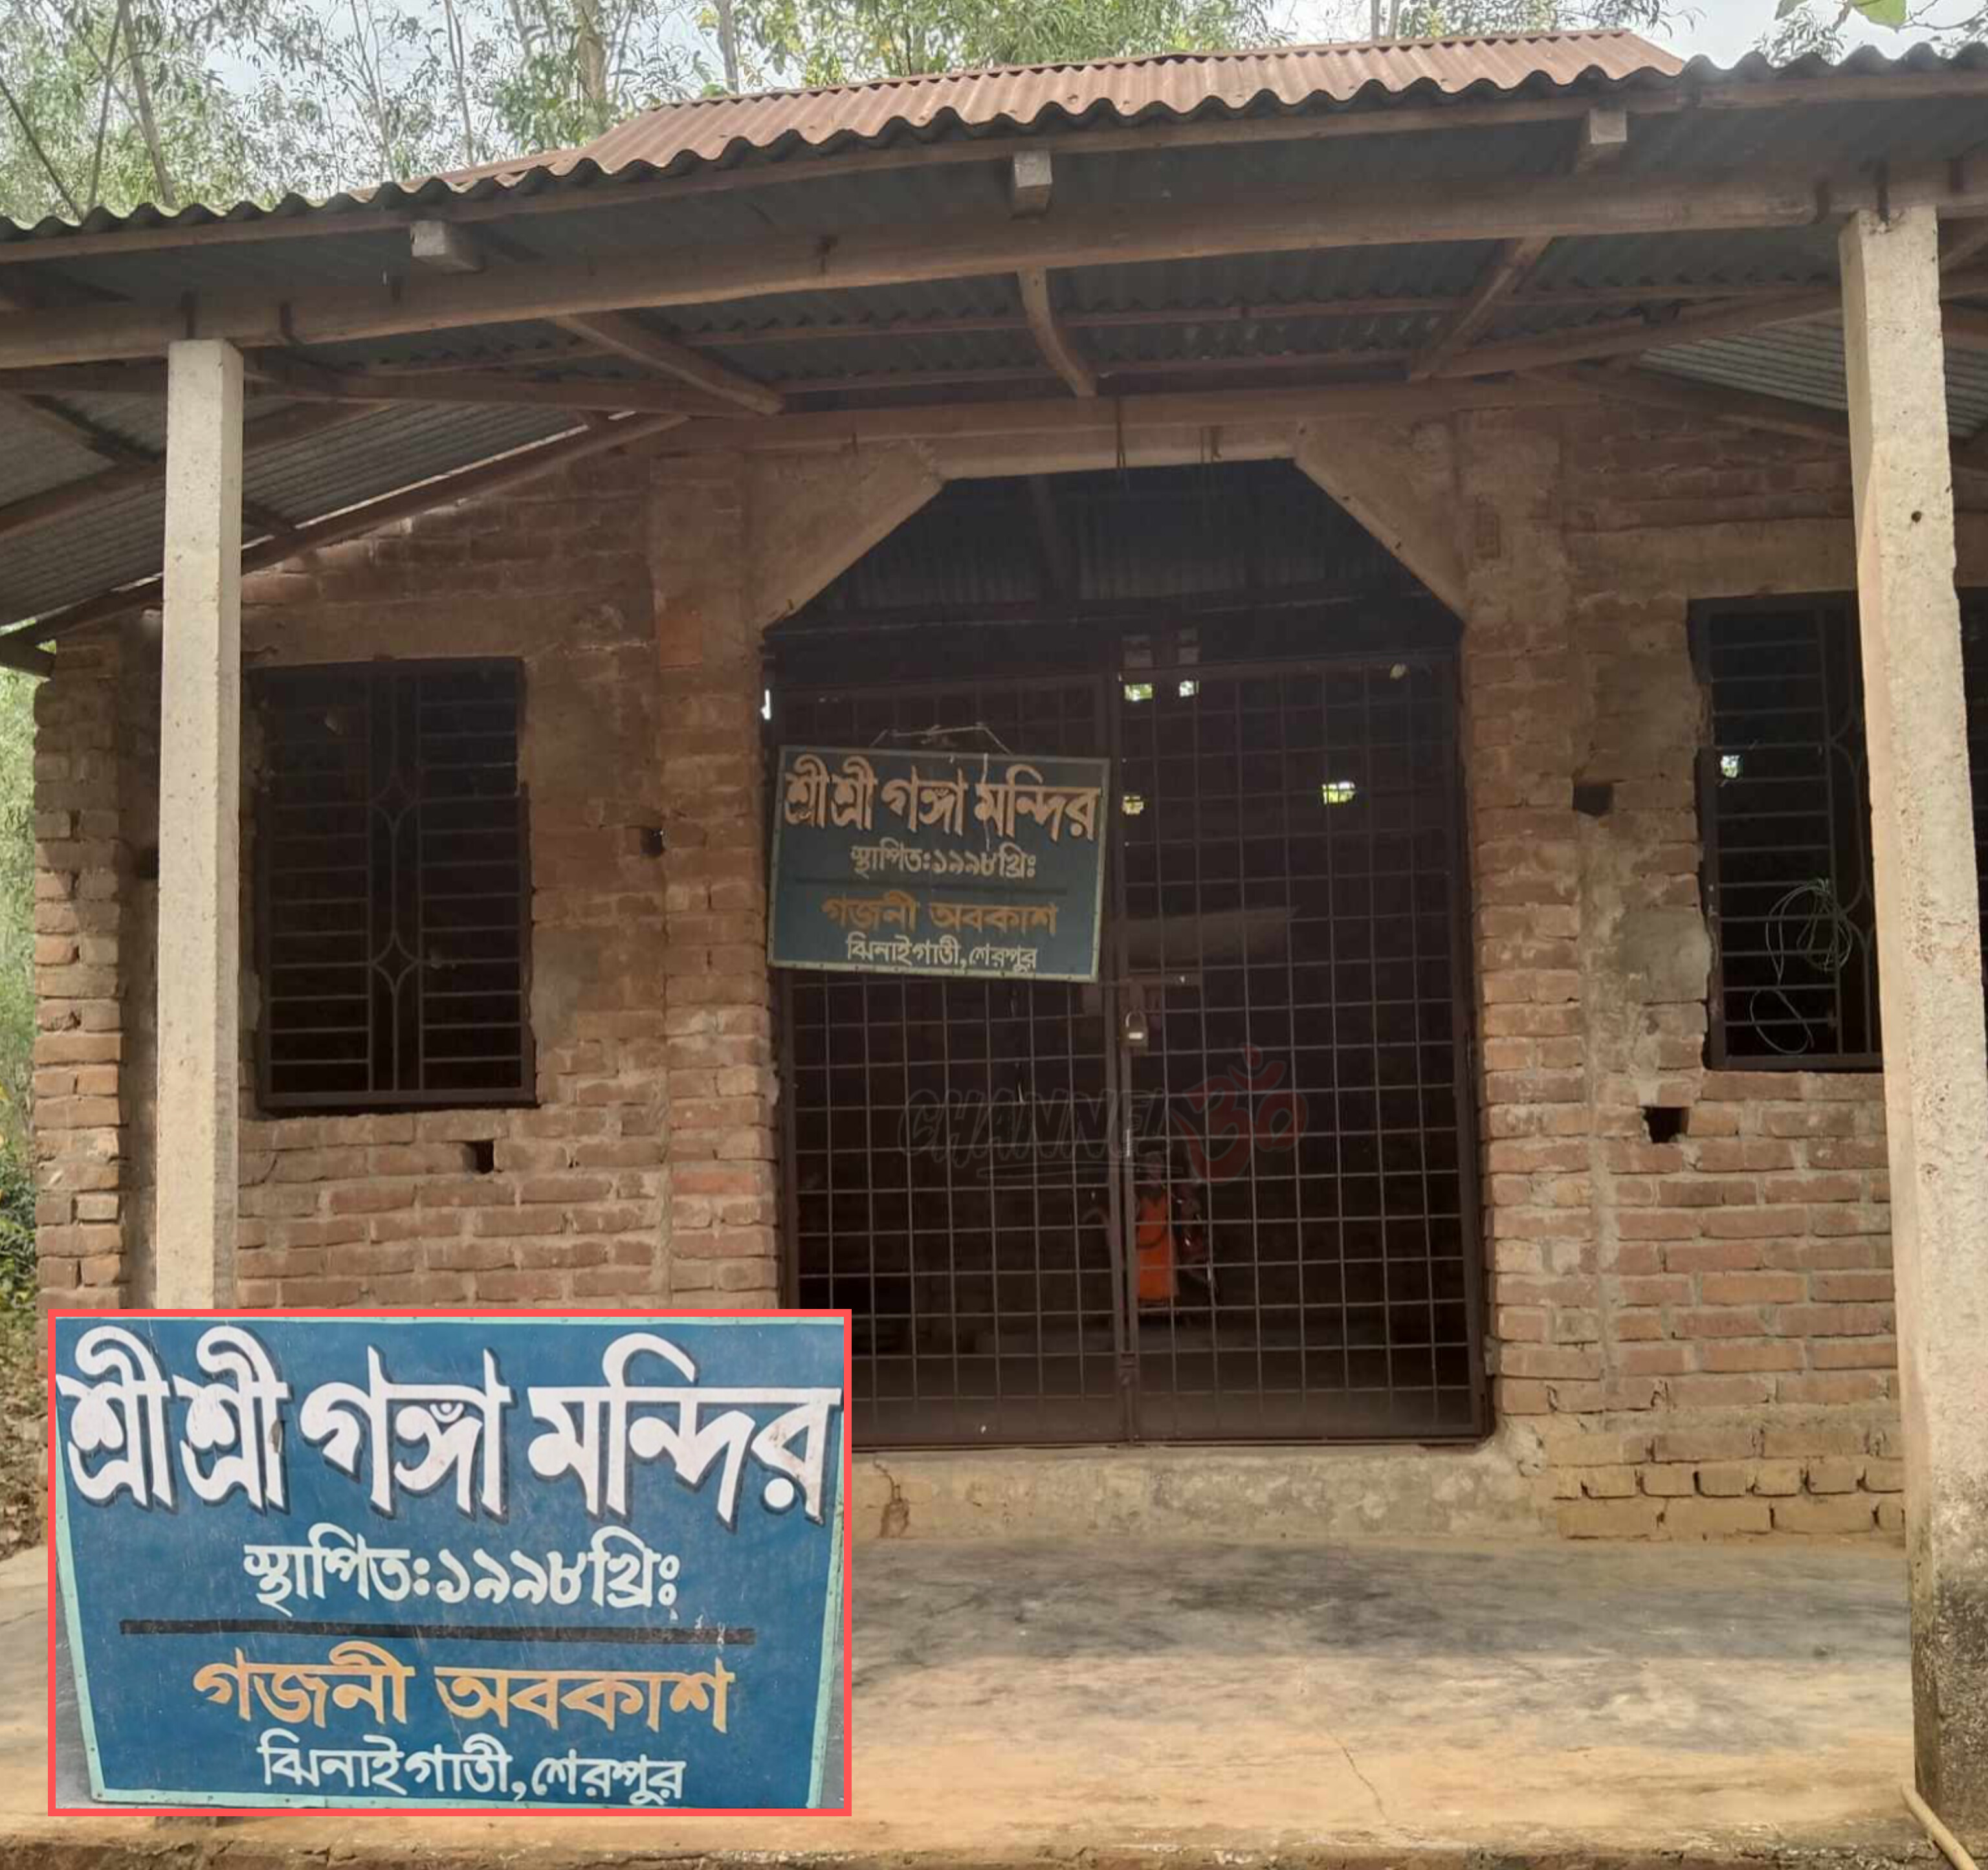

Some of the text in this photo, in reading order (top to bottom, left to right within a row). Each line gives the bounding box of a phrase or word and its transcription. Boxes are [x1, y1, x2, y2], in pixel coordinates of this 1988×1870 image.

[975, 764, 1101, 841] মন্দির
[821, 890, 1058, 936] গজনী অবকাশ
[525, 1332, 844, 1528] মন্দির
[193, 1640, 735, 1733] গজনী অবকাশ
